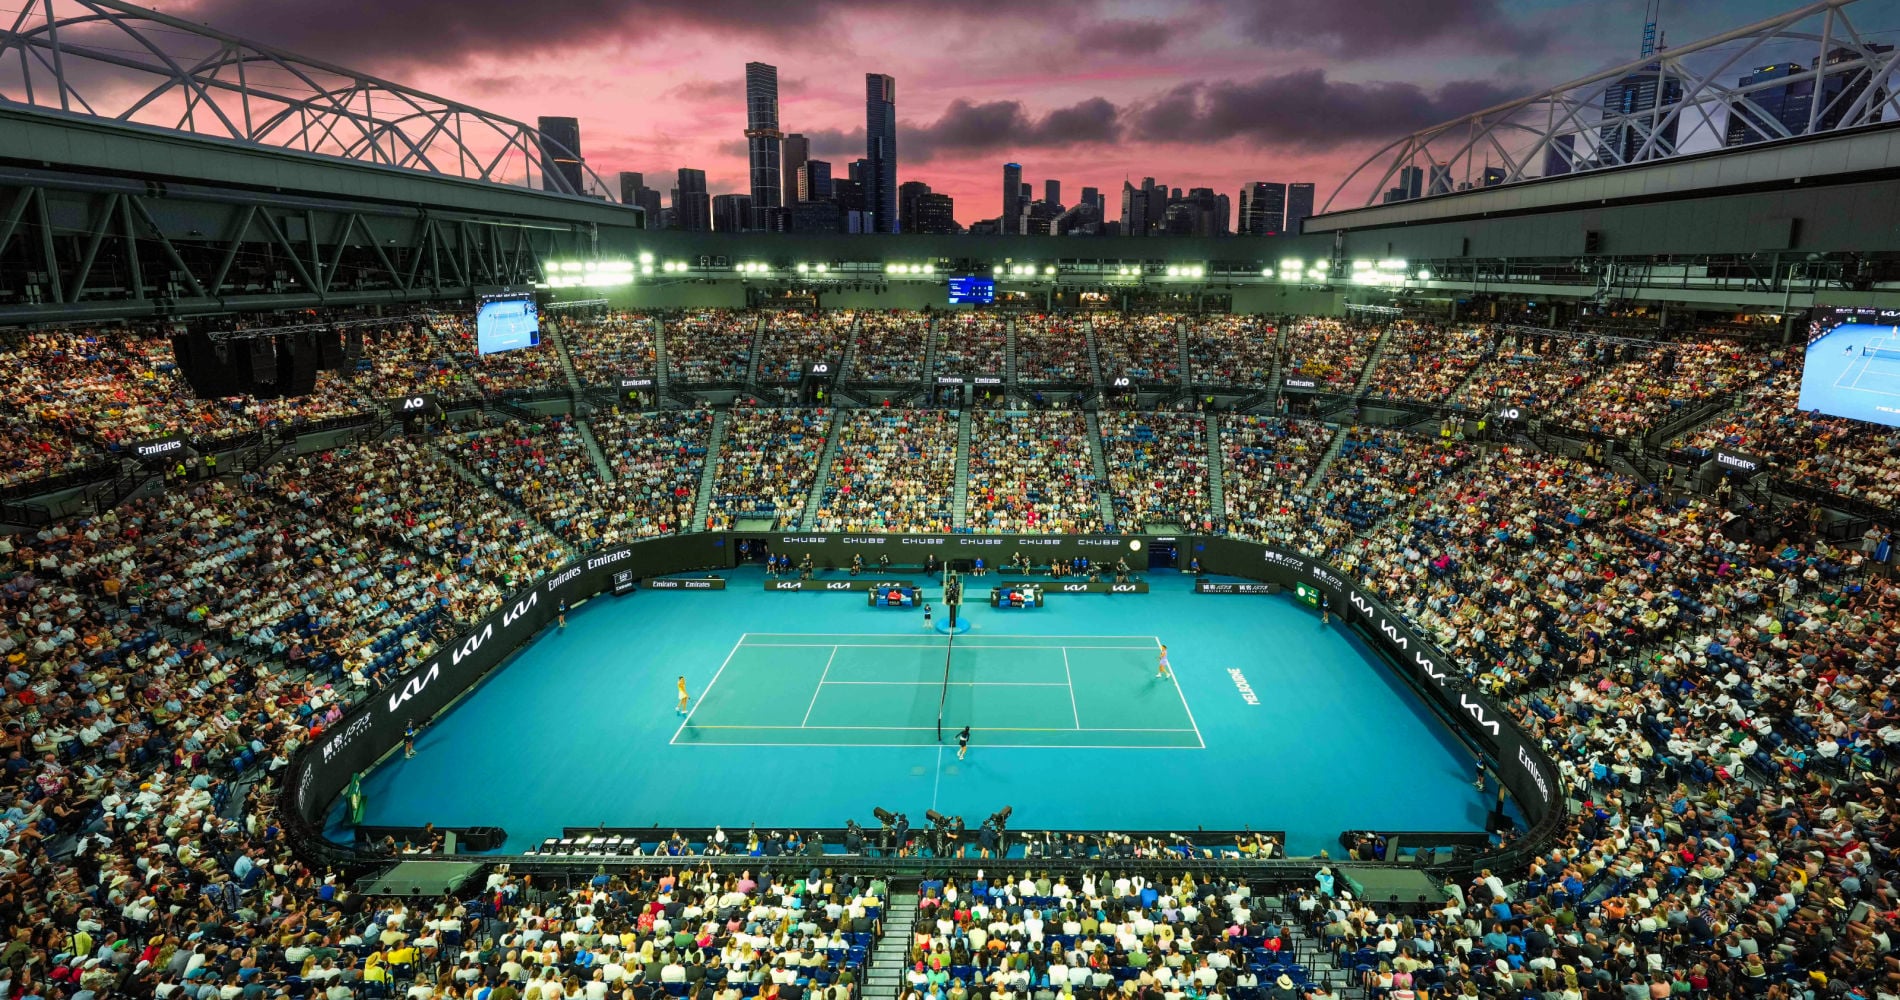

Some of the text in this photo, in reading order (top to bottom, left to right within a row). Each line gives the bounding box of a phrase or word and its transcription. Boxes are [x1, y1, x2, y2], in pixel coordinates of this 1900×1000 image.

[813, 364, 828, 373] AO
[622, 379, 651, 387] Emirates
[1114, 378, 1130, 386] AO
[1286, 380, 1315, 388] Emirates
[404, 398, 424, 409] AO
[1500, 408, 1519, 418] AO
[138, 439, 182, 455] Emirates
[1718, 452, 1756, 470] Emirates
[588, 549, 632, 570] Emirates
[548, 566, 581, 592] Emirates
[503, 591, 538, 628] KIA
[1350, 591, 1374, 618] KIA
[452, 624, 492, 666] KIA
[1381, 619, 1408, 650] KIA
[1416, 652, 1446, 686] KIA
[388, 662, 439, 713] KIA
[1460, 694, 1500, 736] KIA
[1518, 744, 1548, 803] Emirates
